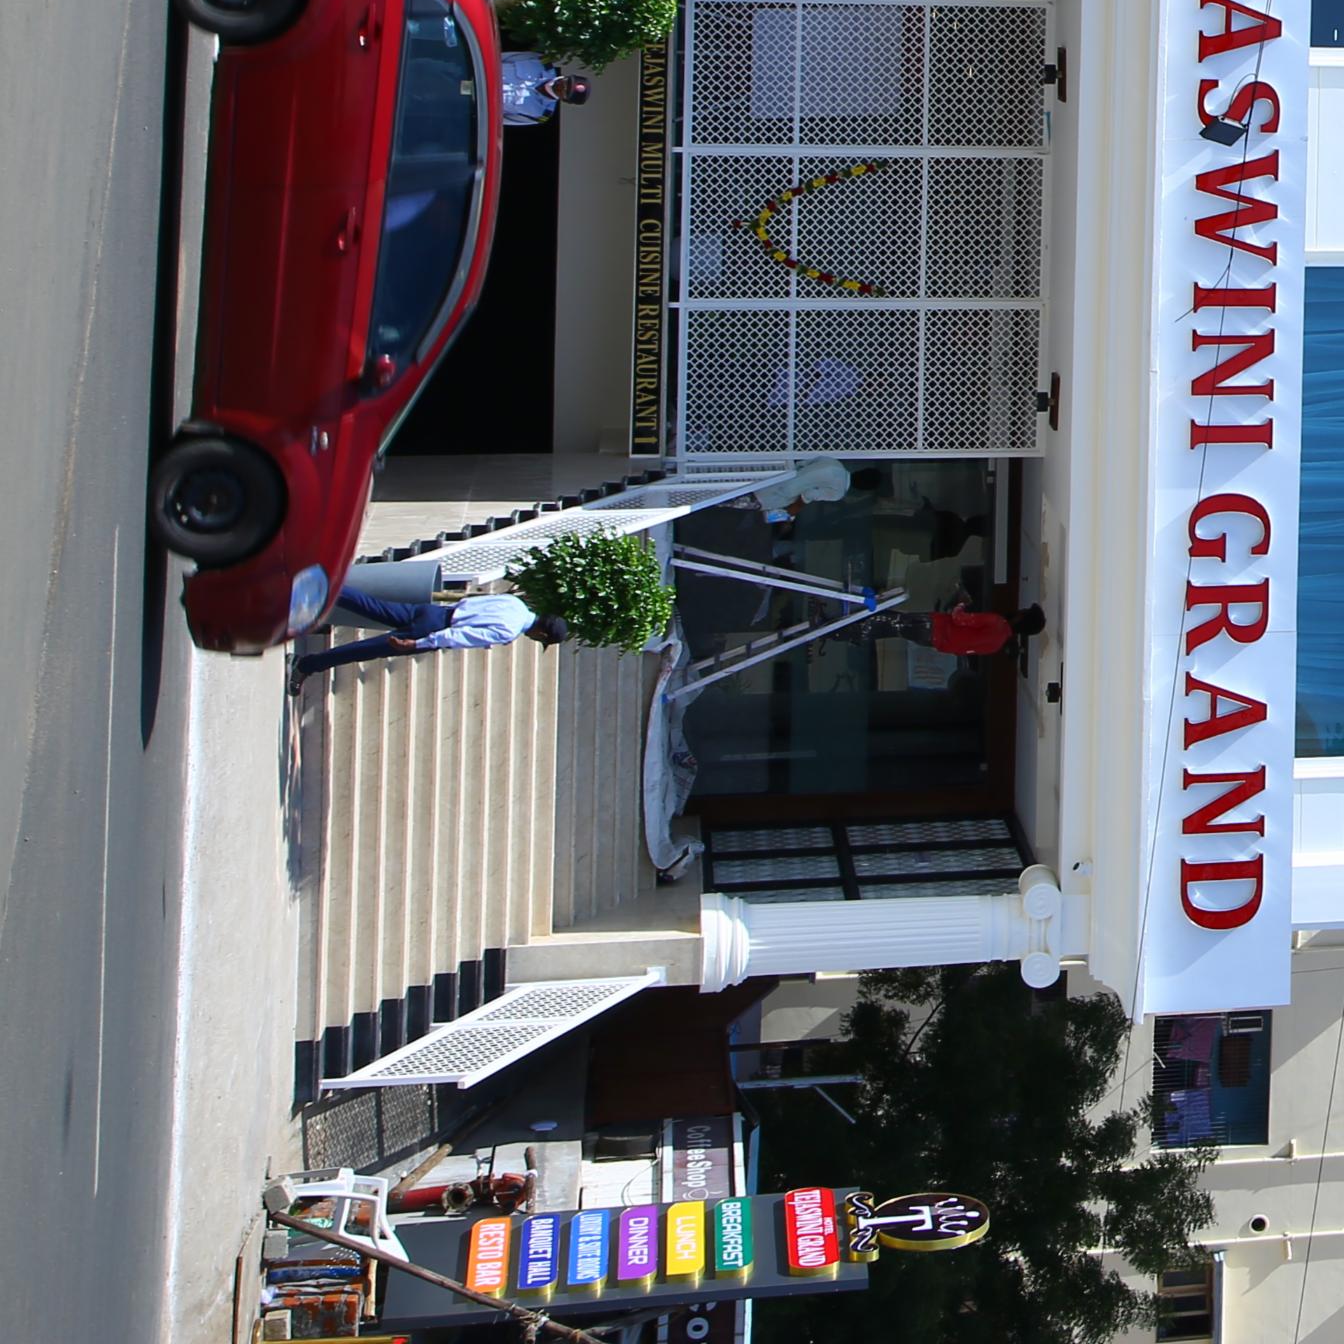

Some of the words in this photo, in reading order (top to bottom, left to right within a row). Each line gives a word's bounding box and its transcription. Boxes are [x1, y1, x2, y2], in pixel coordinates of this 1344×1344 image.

[640, 142, 663, 204] MULTI
[638, 219, 662, 297] CUISINE
[634, 303, 660, 431] RESTAURANT
[1180, 493, 1271, 931] GRAND
[579, 1213, 603, 1236] LUXURY
[787, 1189, 823, 1235] TEJASWINI
[823, 1216, 834, 1235] HOTEL
[476, 1223, 506, 1259] RESTO
[527, 1218, 554, 1259] BANQUET
[577, 1241, 602, 1258] SUITE
[626, 1217, 649, 1266] DINNER
[675, 1215, 696, 1260] LUNCH
[721, 1202, 743, 1267] BREAKFAST
[796, 1235, 826, 1267] GRAND
[474, 1261, 503, 1287] BAR
[526, 1261, 552, 1284] HALL
[575, 1257, 601, 1280] ROOMS
